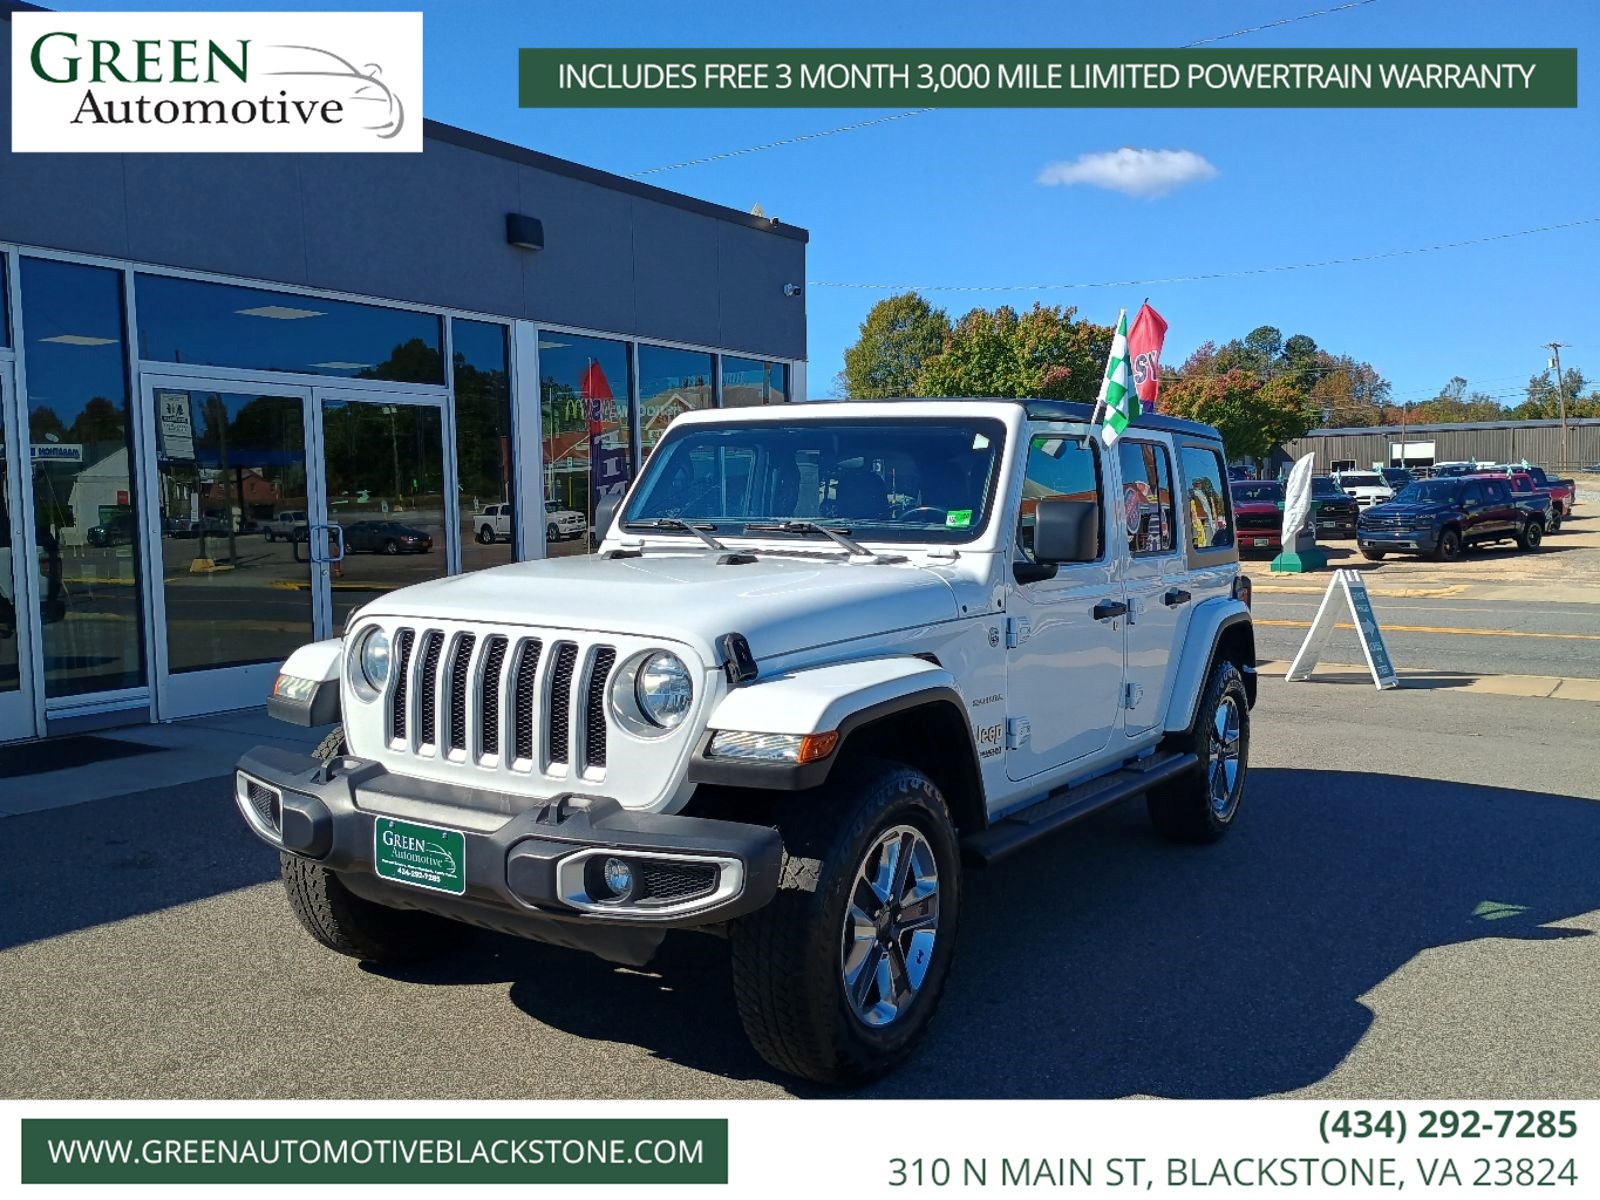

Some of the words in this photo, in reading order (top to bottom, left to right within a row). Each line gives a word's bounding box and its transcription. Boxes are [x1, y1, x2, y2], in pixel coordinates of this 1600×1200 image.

[976, 724, 1002, 745] Jeep
[382, 830, 426, 853] GREEN
[391, 847, 443, 868] Automotive
